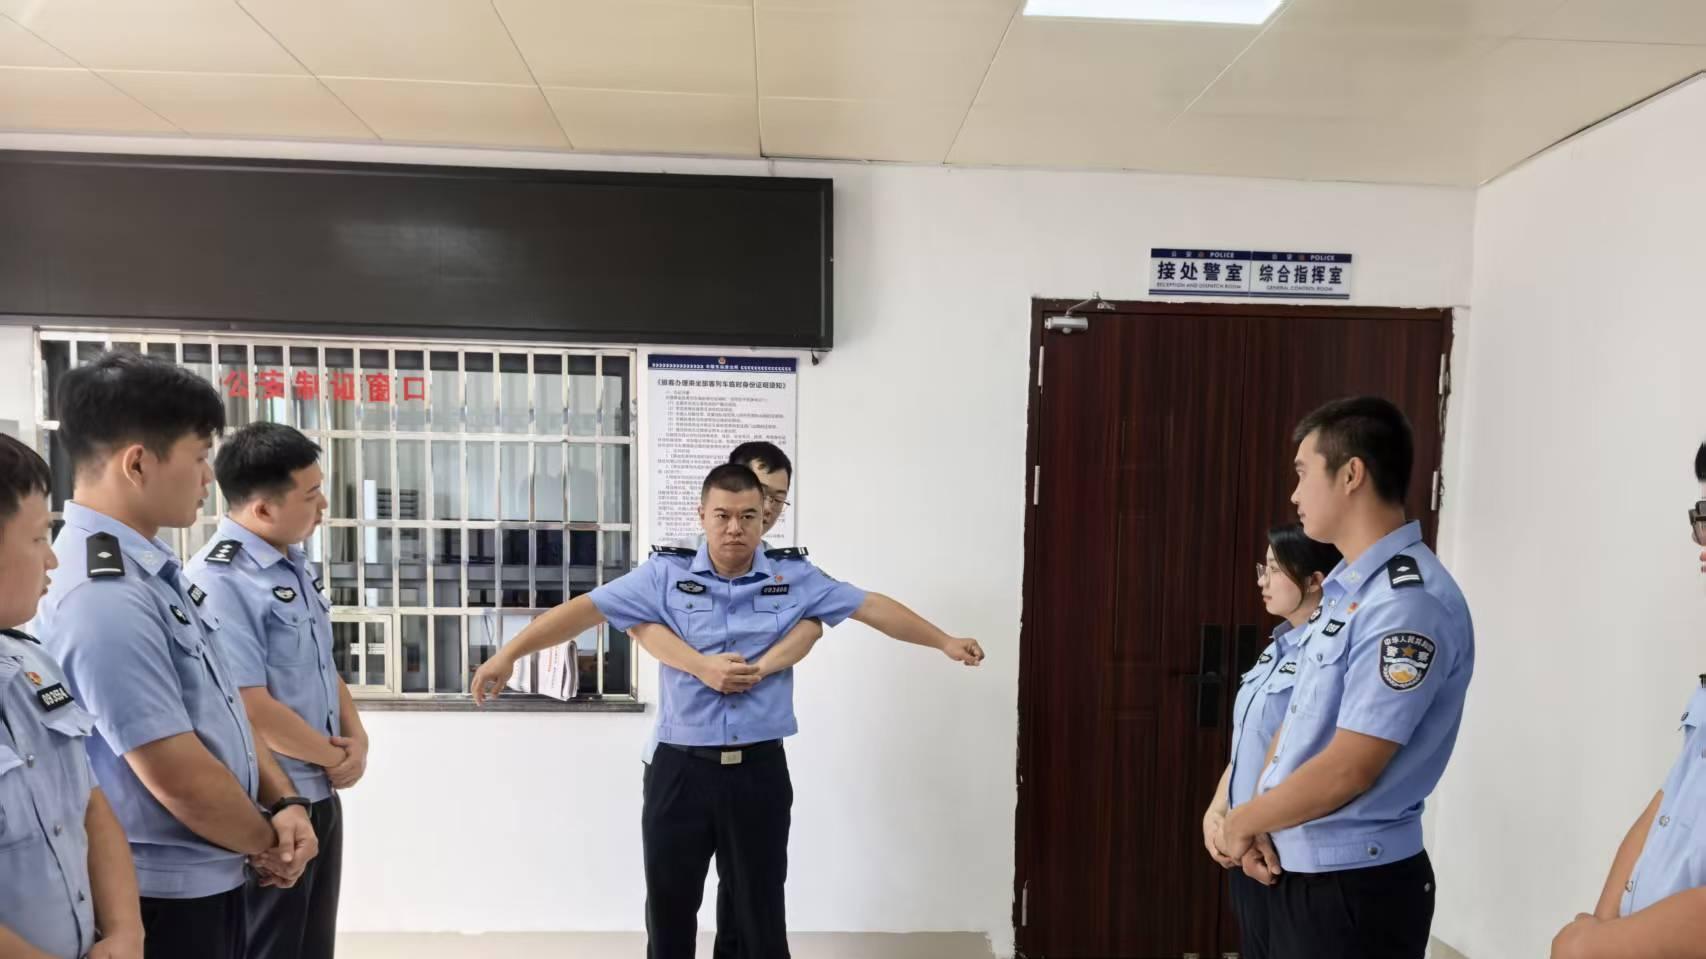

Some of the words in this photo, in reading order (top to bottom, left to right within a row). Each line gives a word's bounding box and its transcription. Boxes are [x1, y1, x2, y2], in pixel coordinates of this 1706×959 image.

[1209, 251, 1235, 259] POLICE
[1157, 260, 1243, 282] 接处警室
[1259, 264, 1343, 285] 综合指挥室
[223, 368, 425, 402] 公安制证窗口
